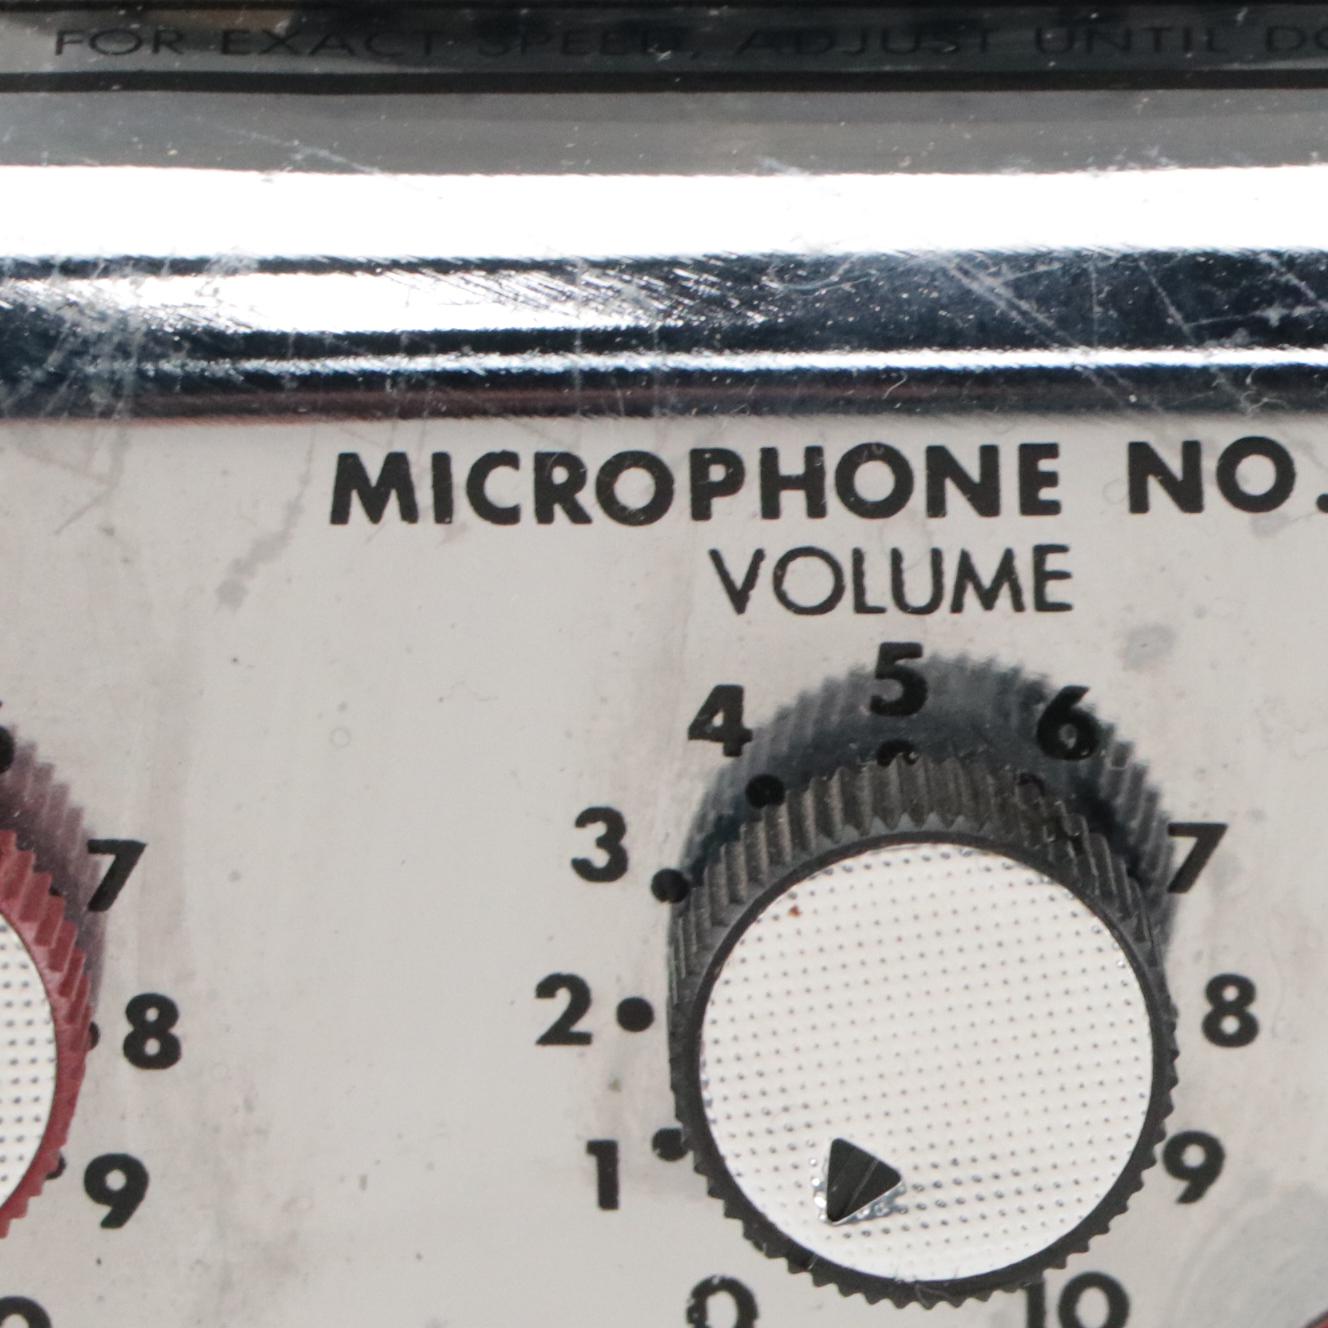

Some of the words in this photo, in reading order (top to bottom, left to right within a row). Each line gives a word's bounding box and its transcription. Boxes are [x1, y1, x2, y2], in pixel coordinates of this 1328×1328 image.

[54, 27, 185, 57] FOR
[220, 28, 438, 58] EXACT
[733, 26, 1001, 57] ADJUST
[1034, 25, 1232, 55] UNTIL
[330, 442, 1060, 526] MICROPHONE
[708, 544, 1073, 616] VOLUME
[870, 642, 928, 717] 5
[688, 685, 752, 757] 4
[1037, 686, 1098, 760] 6
[88, 839, 147, 912] 7
[571, 807, 629, 883] 3
[1168, 823, 1227, 893] 7
[124, 994, 181, 1070] 8
[535, 973, 593, 1045] 2
[1202, 974, 1259, 1047] 8
[84, 1153, 149, 1229] 9
[586, 1140, 619, 1210] 1
[1163, 1131, 1225, 1204] 9
